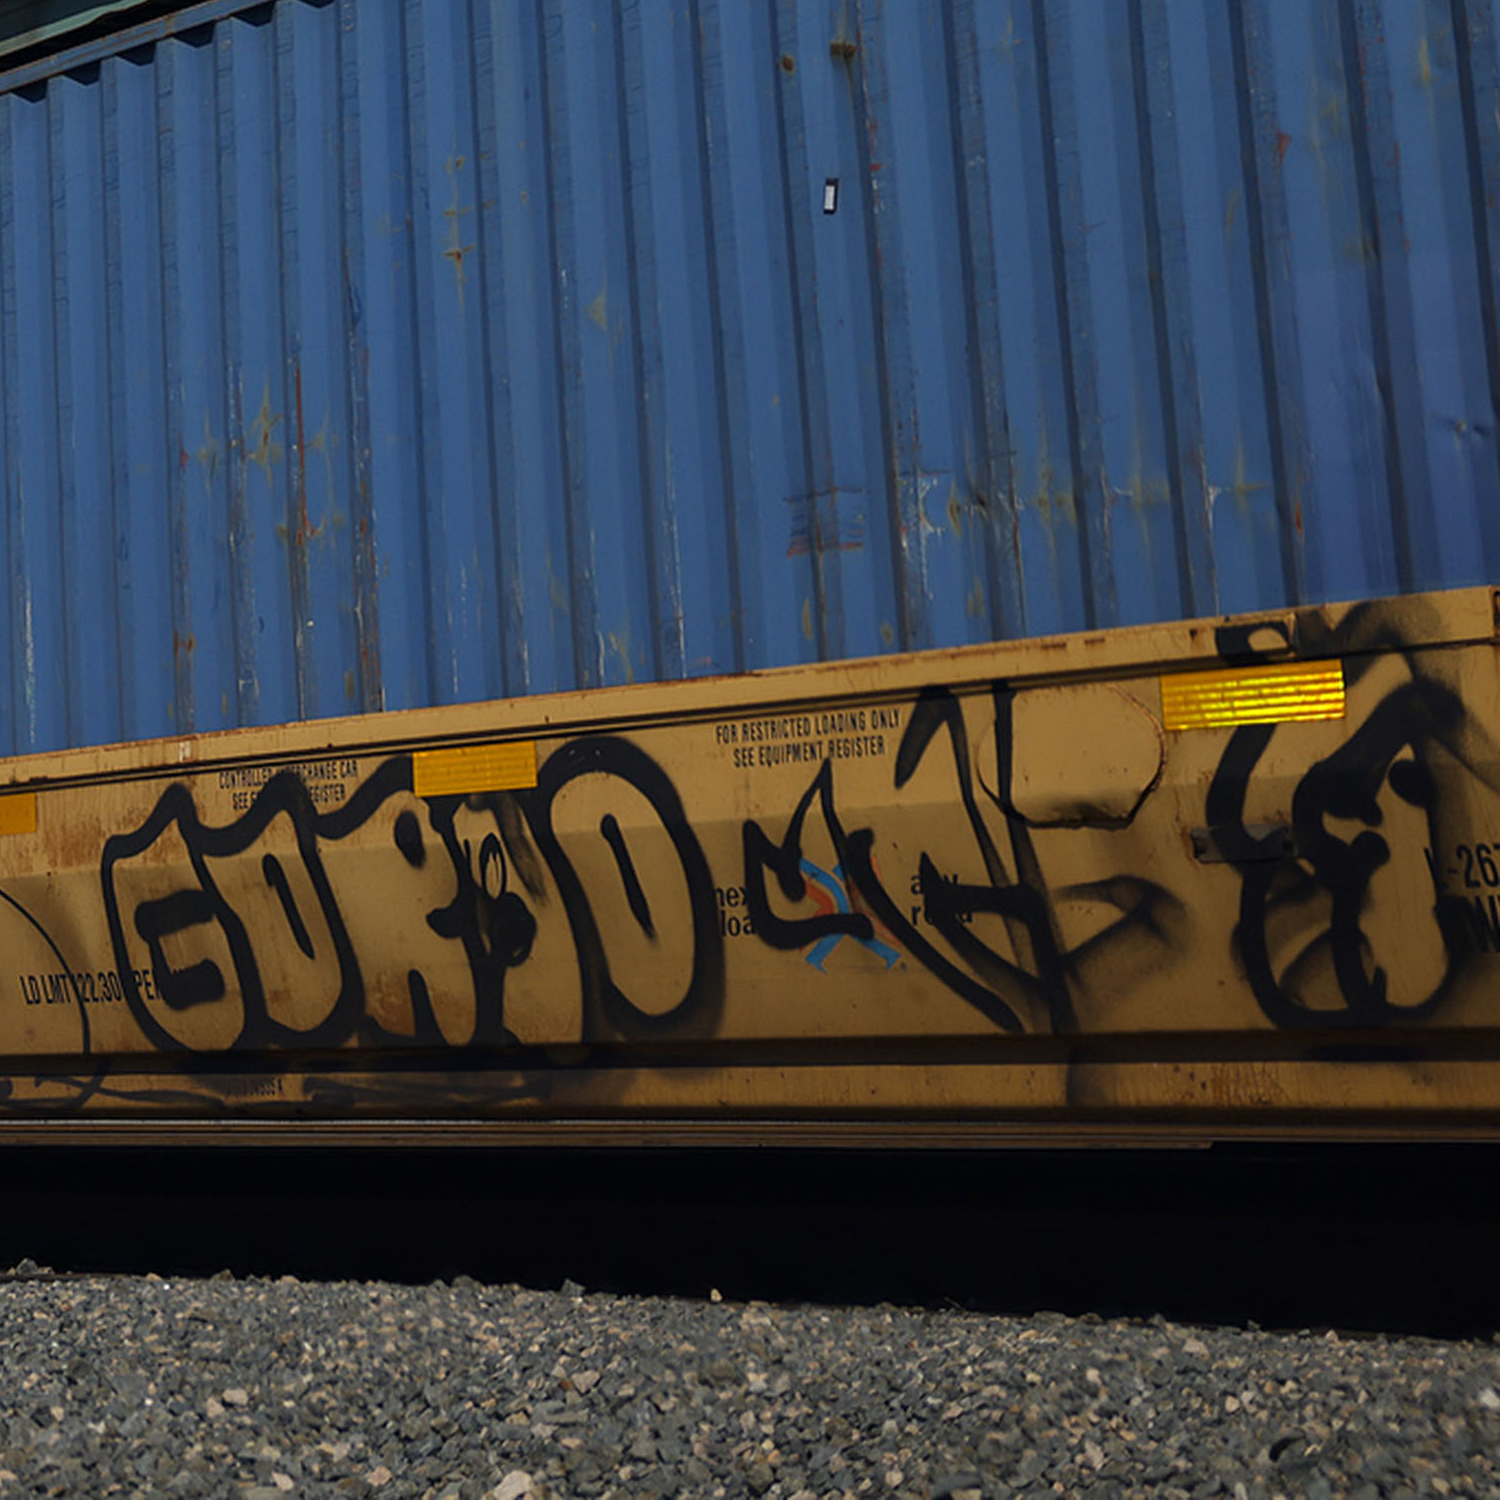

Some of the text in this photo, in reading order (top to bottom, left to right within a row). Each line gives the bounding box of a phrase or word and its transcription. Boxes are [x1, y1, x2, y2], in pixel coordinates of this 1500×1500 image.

[716, 708, 901, 744] FOR RESTRICTED LOADING ONLY
[733, 735, 886, 768] SEE EQUIPMENT REGISTER
[340, 759, 358, 778] CAR
[232, 791, 250, 811] SEE
[307, 783, 346, 803] EGISTER
[19, 974, 39, 1005] LD
[42, 973, 72, 1004] LMT
